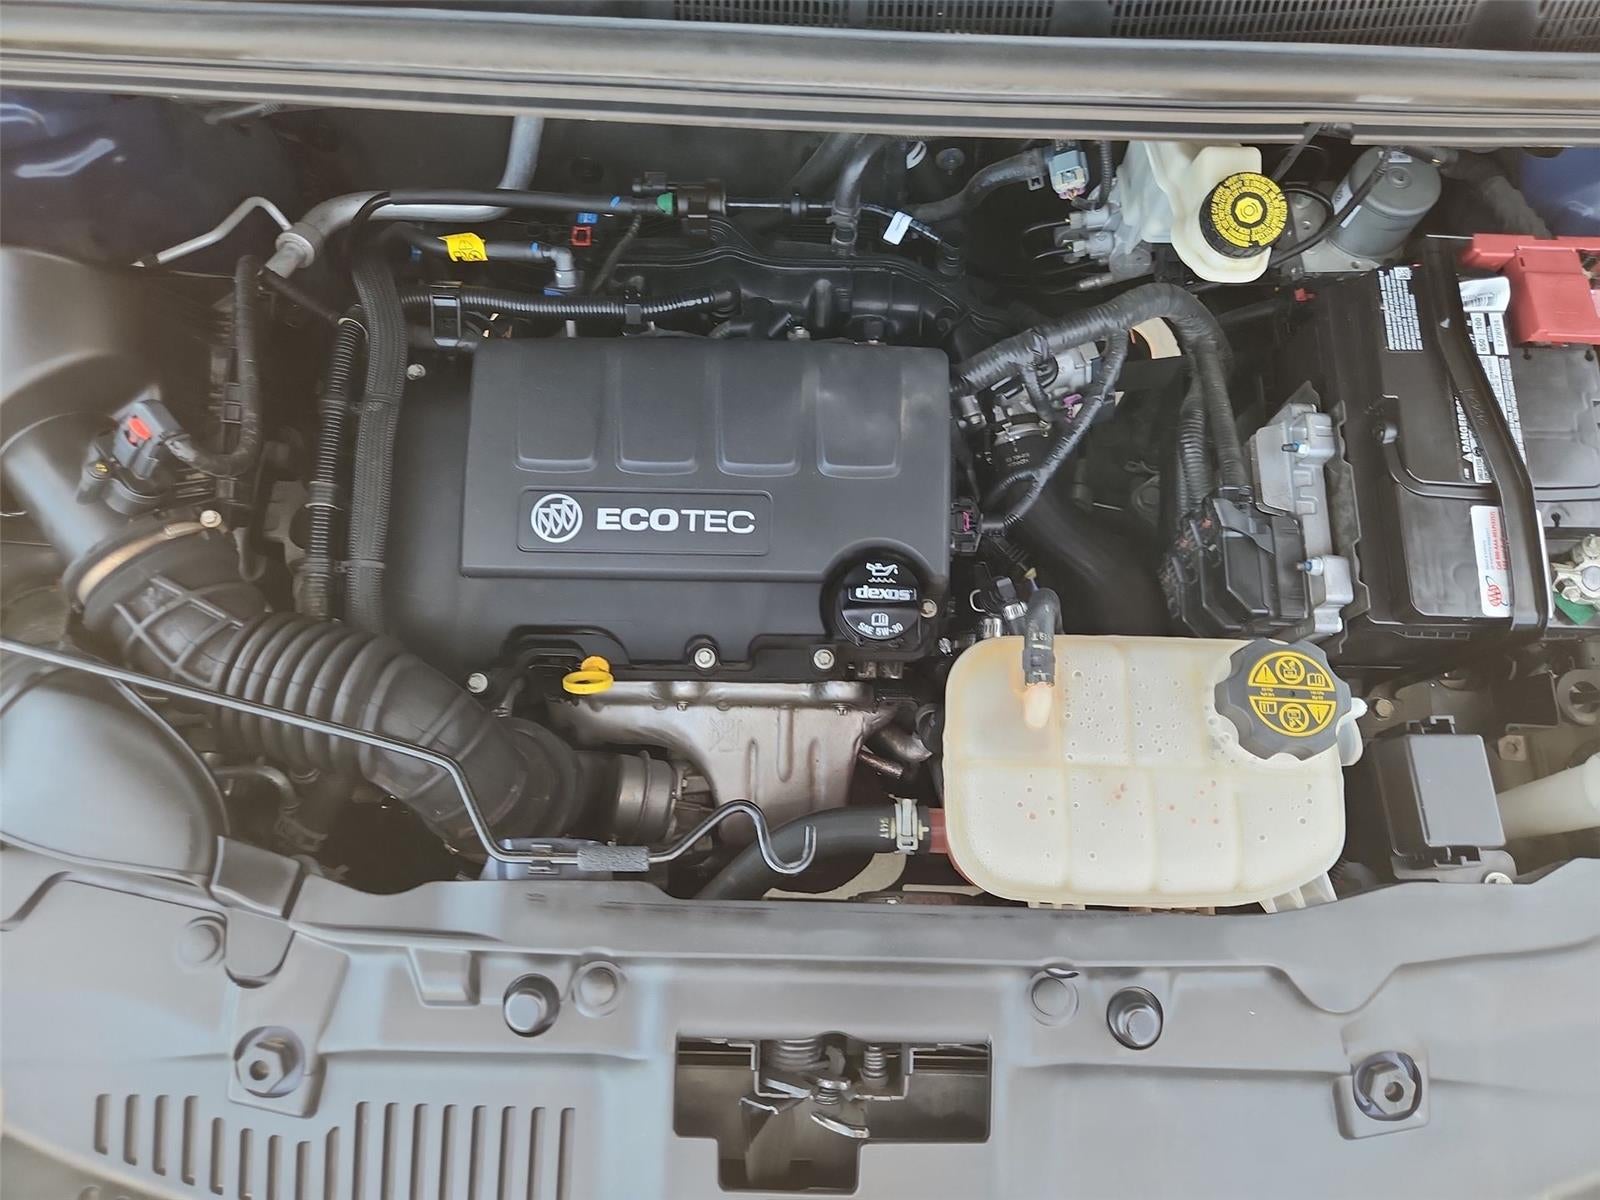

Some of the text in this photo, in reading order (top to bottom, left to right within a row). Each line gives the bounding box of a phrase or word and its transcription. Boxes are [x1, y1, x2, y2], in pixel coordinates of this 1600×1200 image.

[597, 508, 756, 534] ECOTEC
[855, 585, 911, 601] dexos
[857, 622, 904, 636] SAE 5W-30
